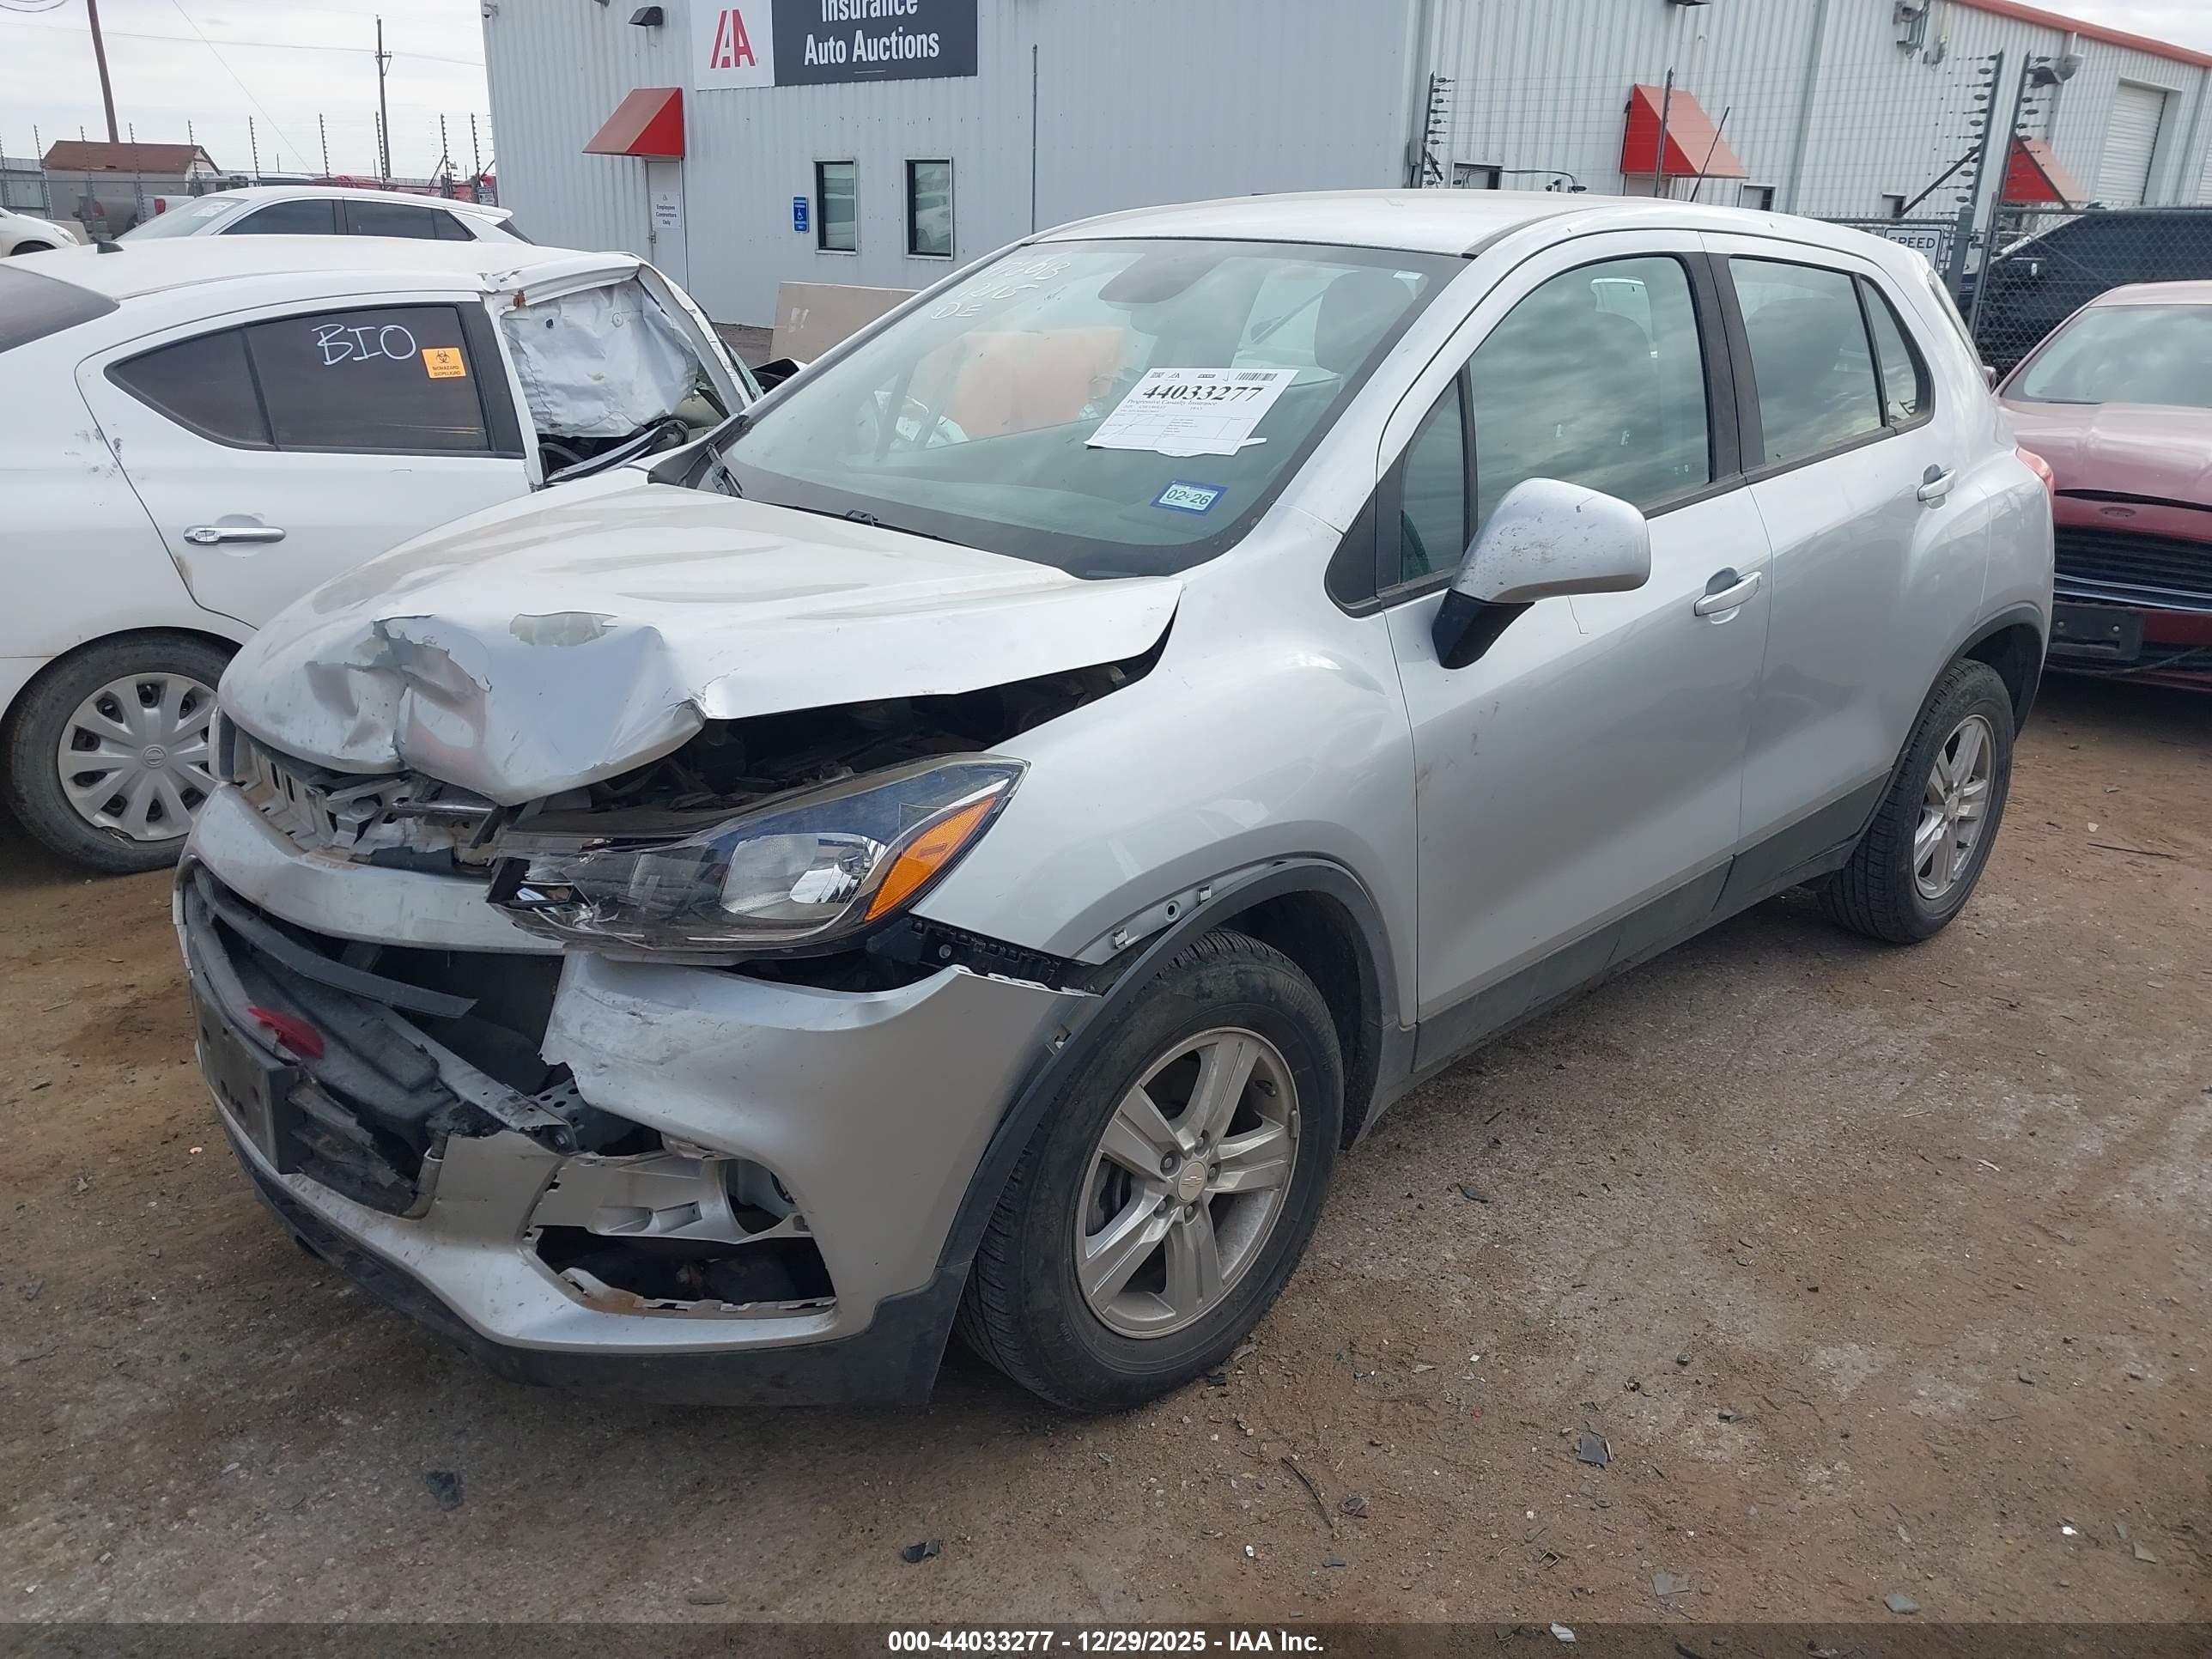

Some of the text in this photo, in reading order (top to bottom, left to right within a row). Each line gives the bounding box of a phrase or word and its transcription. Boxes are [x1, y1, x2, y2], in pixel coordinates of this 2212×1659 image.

[804, 26, 940, 66] Auto Auctions
[311, 323, 416, 366] BIO
[1142, 384, 1265, 402] 44033277
[1166, 489, 1211, 505] 02 26
